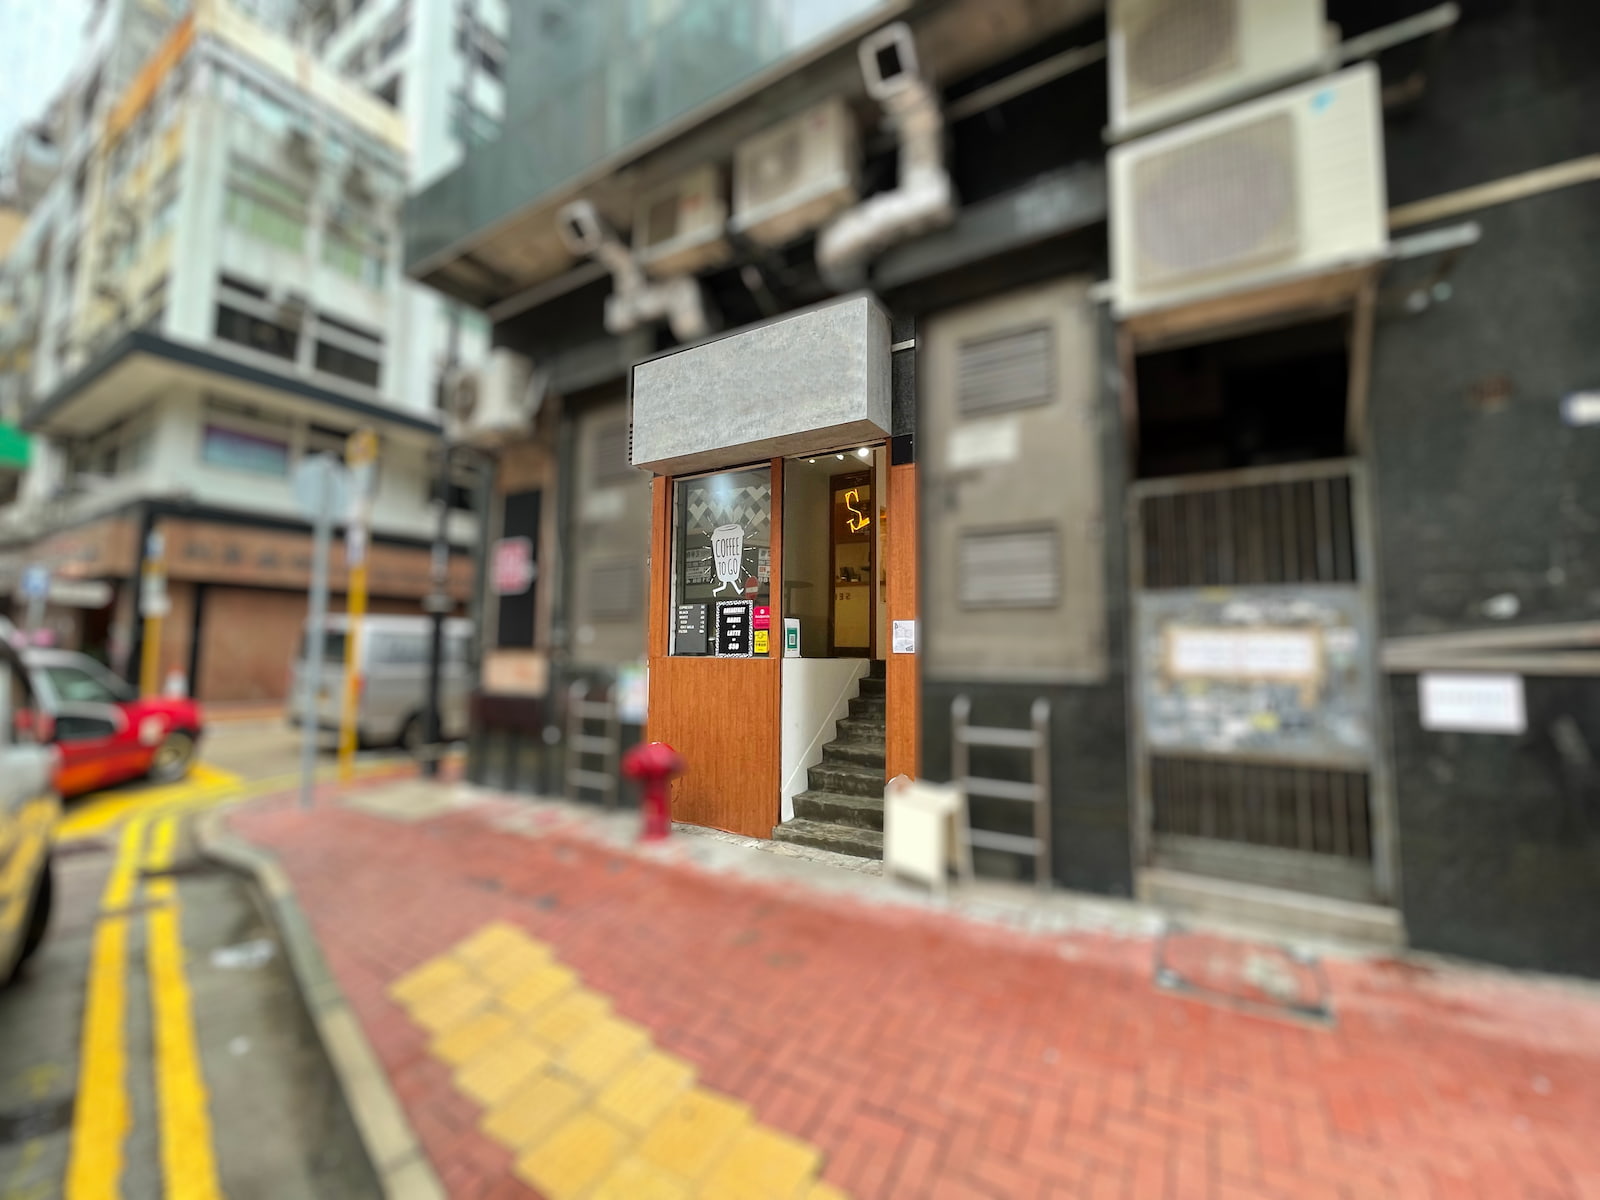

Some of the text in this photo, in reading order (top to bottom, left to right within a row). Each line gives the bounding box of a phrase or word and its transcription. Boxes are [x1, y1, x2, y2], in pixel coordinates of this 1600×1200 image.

[716, 537, 740, 558] COFFEE
[718, 561, 727, 576] TO
[727, 558, 738, 575] GO
